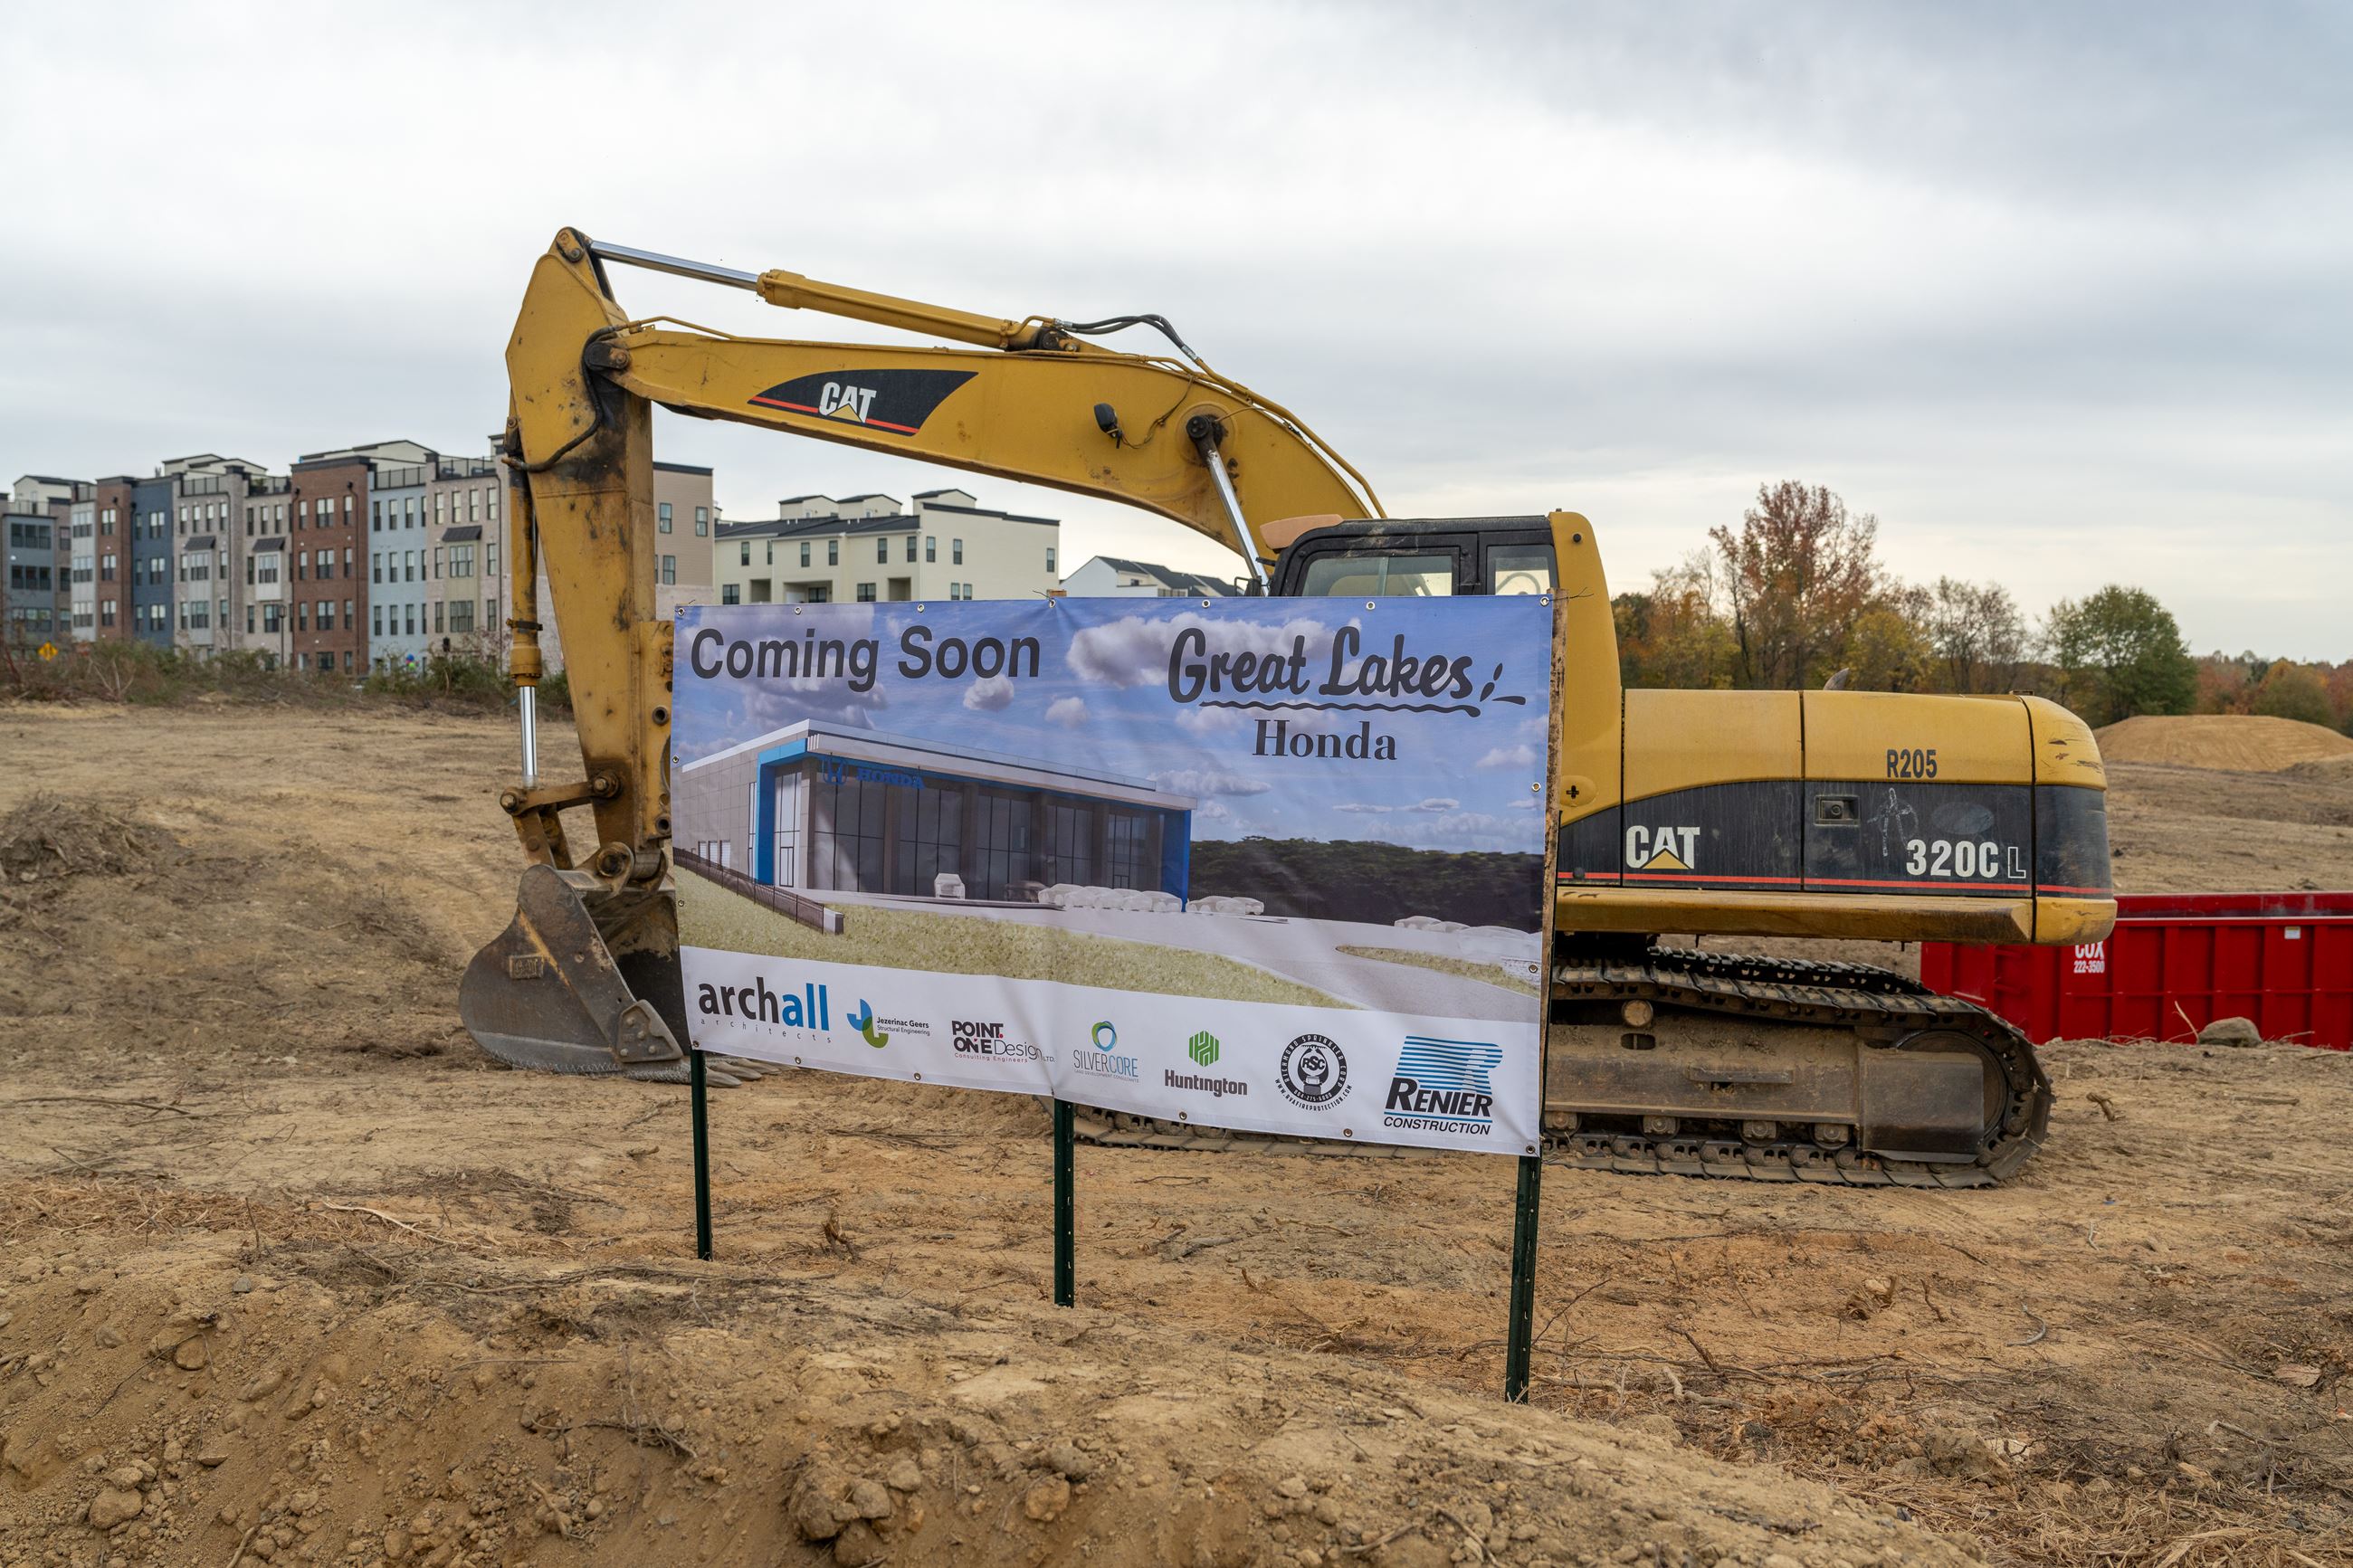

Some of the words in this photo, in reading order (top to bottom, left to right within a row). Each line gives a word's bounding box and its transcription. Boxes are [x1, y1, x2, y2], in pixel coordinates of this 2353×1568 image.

[819, 382, 877, 423] CAT
[691, 629, 880, 693] Coming
[898, 625, 1041, 679] Soon
[1168, 627, 1310, 704] Great
[1319, 626, 1473, 699] Lakes
[1252, 719, 1397, 761] Honda
[856, 767, 926, 790] HONDA
[1886, 748, 1938, 779] R205
[1626, 825, 1700, 870] CAT
[698, 976, 830, 1031] archall
[877, 1016, 909, 1027] Jezerinac
[909, 1020, 929, 1029] Geers
[877, 1024, 900, 1033] Structural
[900, 1027, 930, 1037] Engineering
[954, 1052, 990, 1061] Consulting
[1281, 1040, 1299, 1083] RICHMOND
[1301, 1034, 1344, 1060] SPRINKLER
[1337, 1065, 1347, 1088] CORP
[1302, 1056, 1326, 1071] RSC
[1165, 1069, 1248, 1098] Huntington
[1385, 1077, 1493, 1117] RENIER
[1384, 1117, 1491, 1136] CONSTRUCTION
